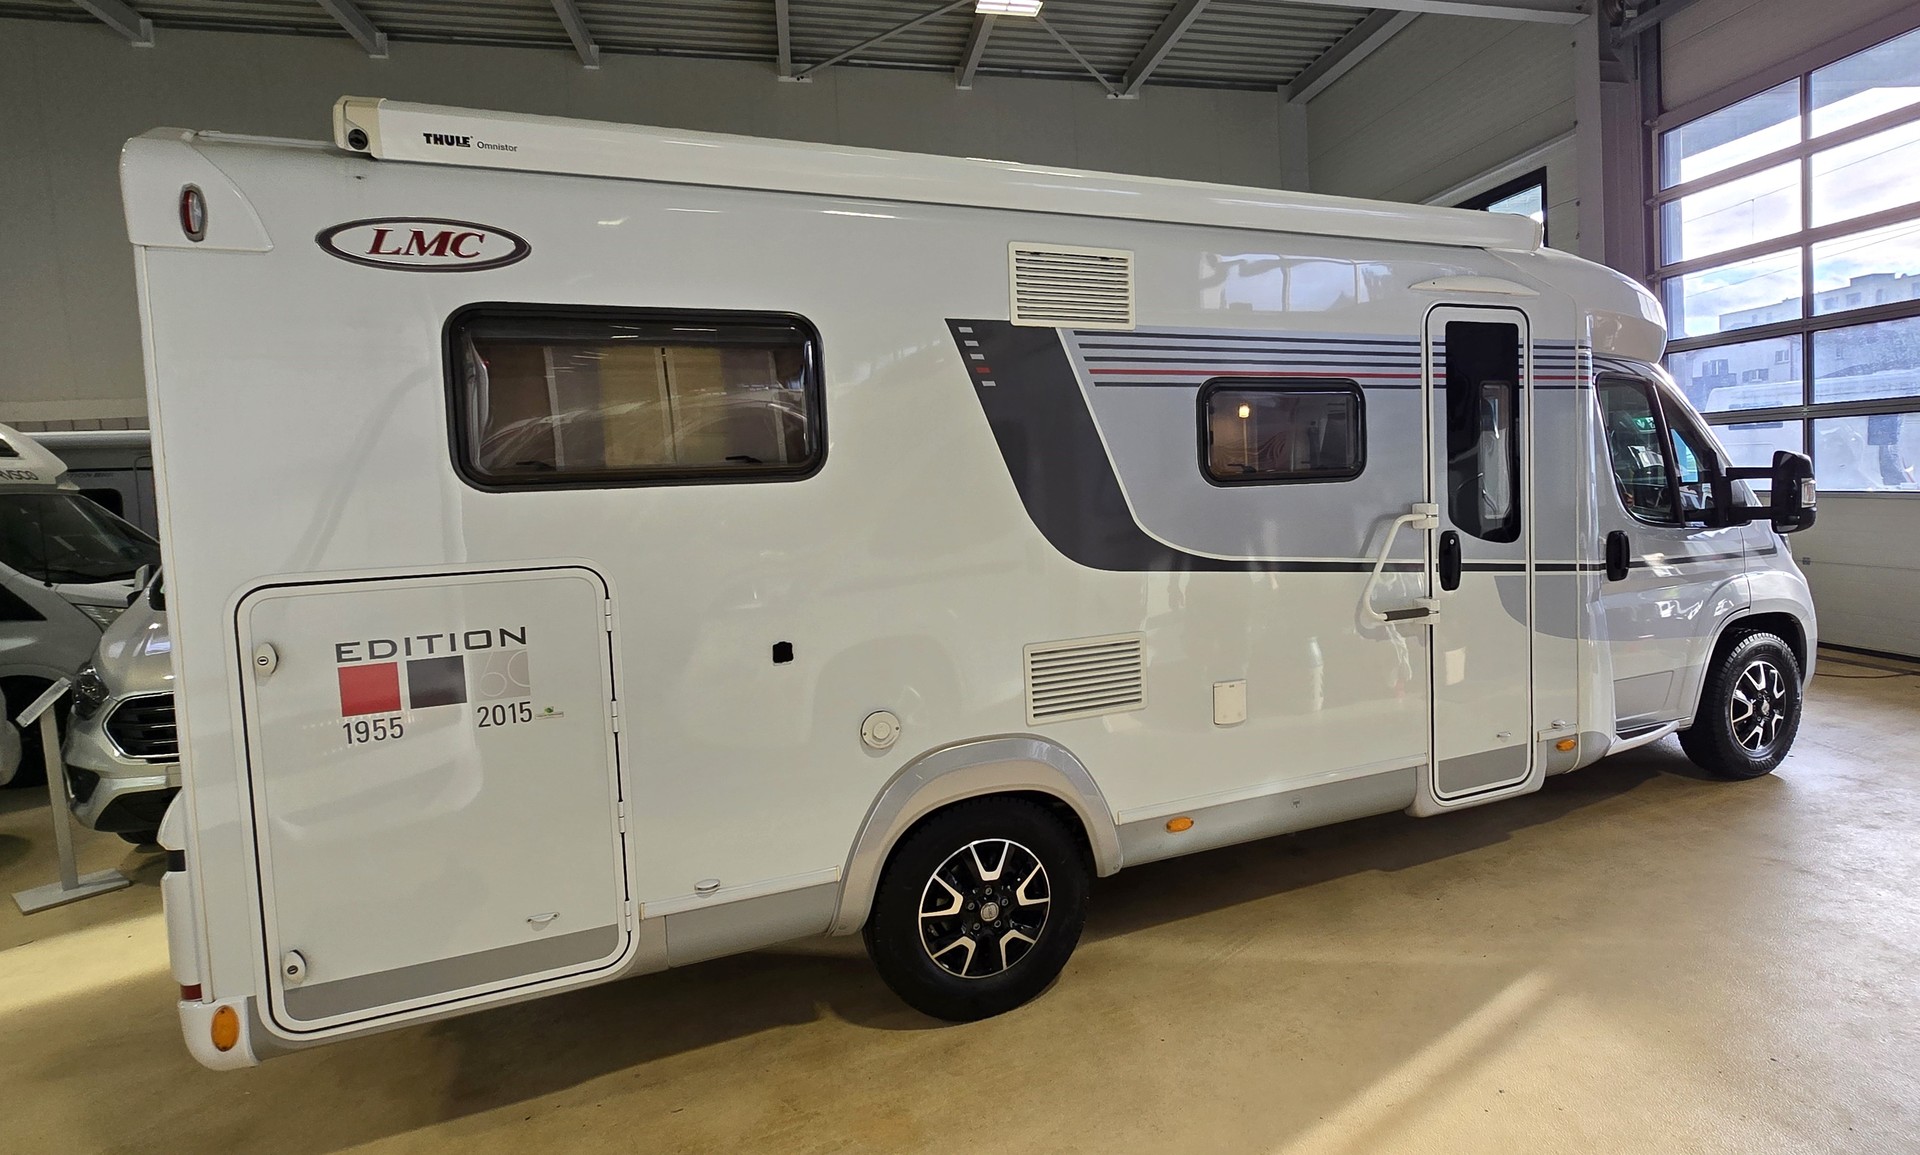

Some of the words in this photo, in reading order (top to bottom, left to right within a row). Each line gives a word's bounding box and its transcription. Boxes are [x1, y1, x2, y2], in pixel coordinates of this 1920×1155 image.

[423, 132, 471, 148] THULE
[477, 141, 518, 152] Omnistor
[367, 227, 485, 259] LMC
[335, 626, 527, 663] EDITION
[477, 701, 533, 728] 2015
[342, 716, 404, 745] 1955
